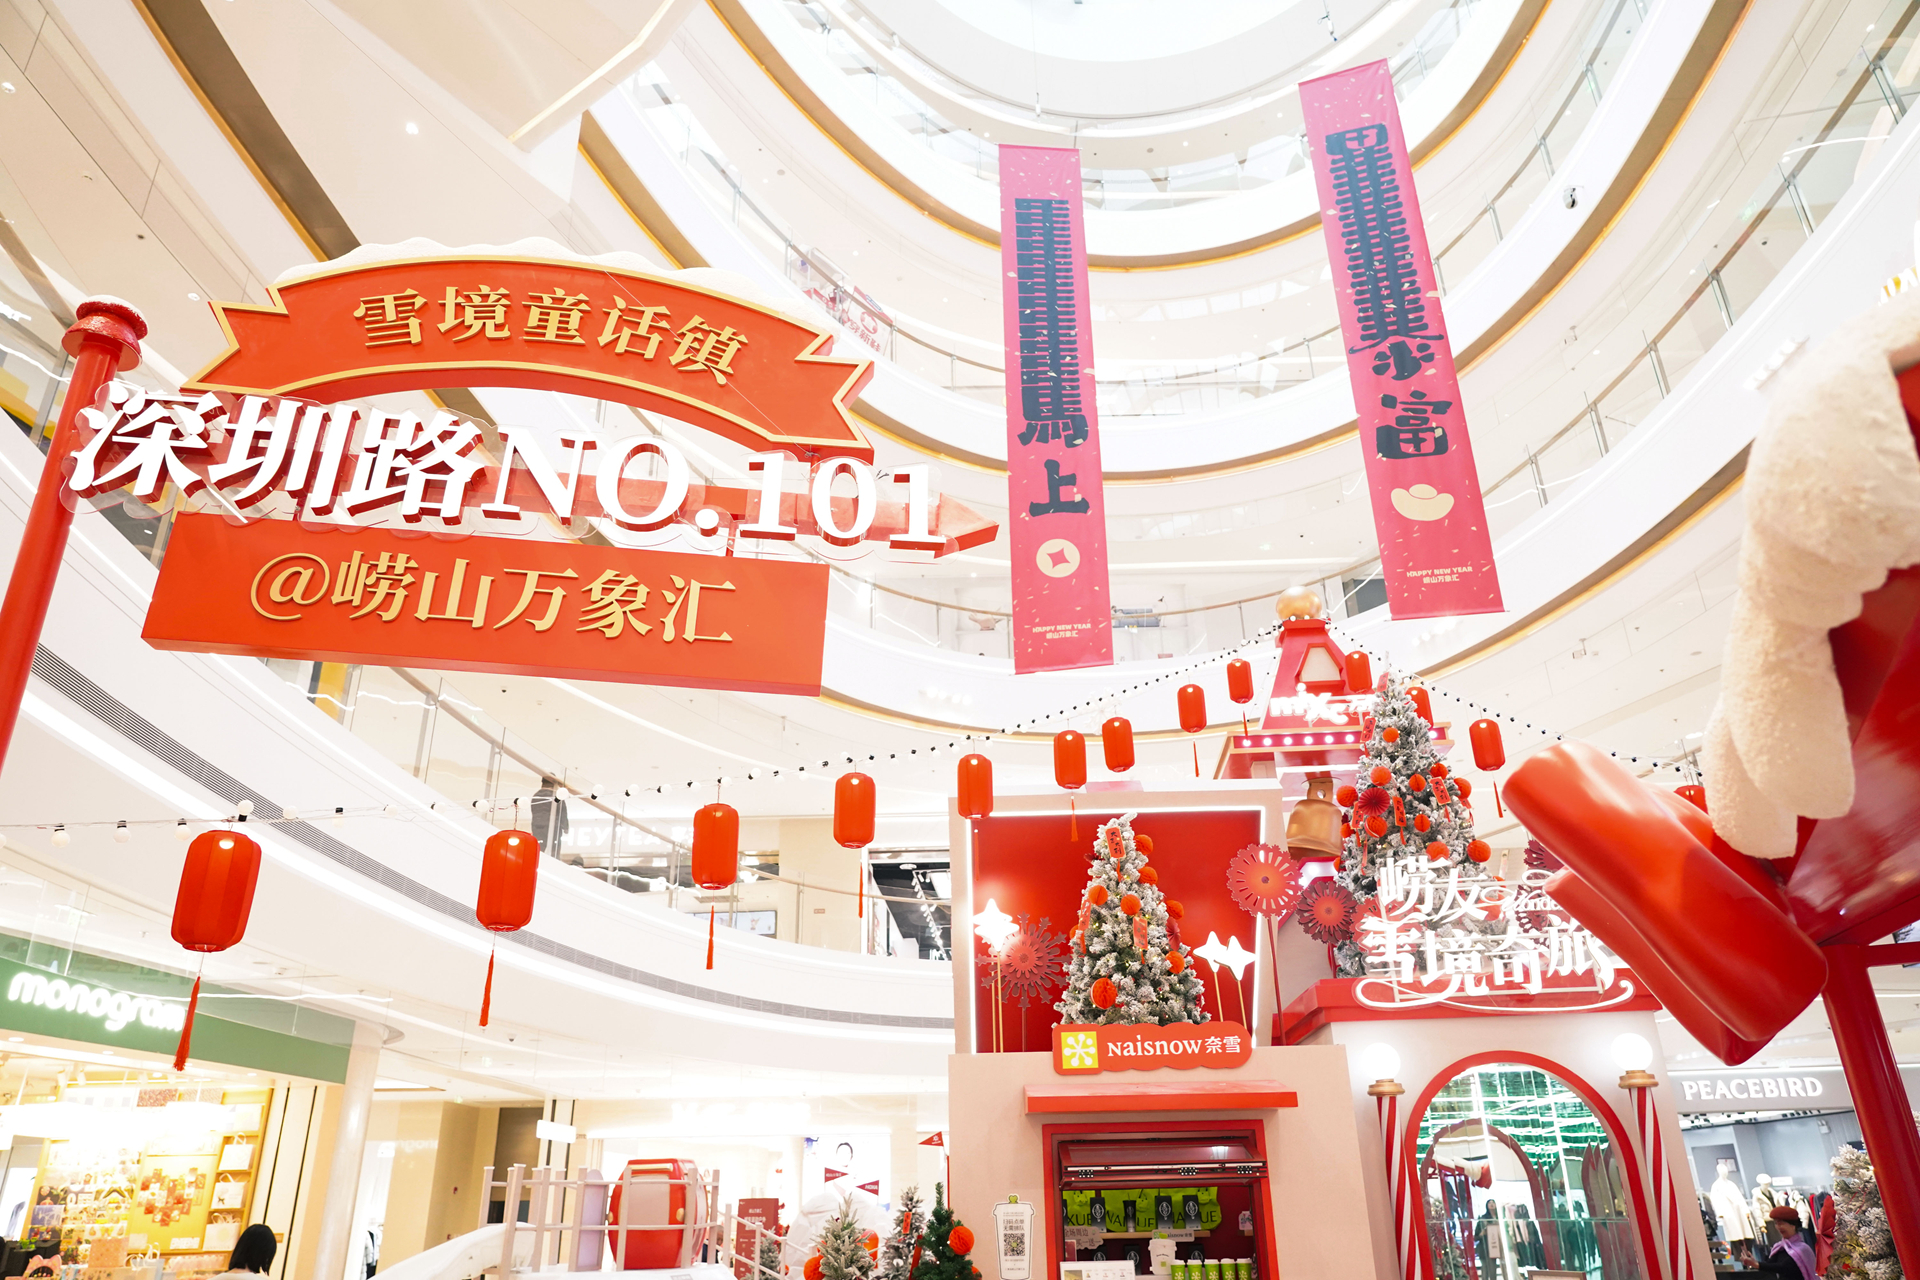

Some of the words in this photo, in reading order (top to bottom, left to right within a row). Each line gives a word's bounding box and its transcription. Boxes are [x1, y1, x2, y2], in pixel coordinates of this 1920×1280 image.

[354, 284, 749, 385] 雪境童话镇
[69, 380, 947, 548] 深圳路NO.101
[251, 551, 736, 644] @崂山万象汇
[1407, 569, 1432, 577] HAPPY
[1032, 625, 1055, 633] HAPPY
[1379, 855, 1488, 923] 崂友
[8, 972, 185, 1031] monogram
[1107, 1035, 1202, 1057] Naisnow
[1204, 1035, 1241, 1054] 奈雪
[1682, 1077, 1823, 1100] PEACEBIRD
